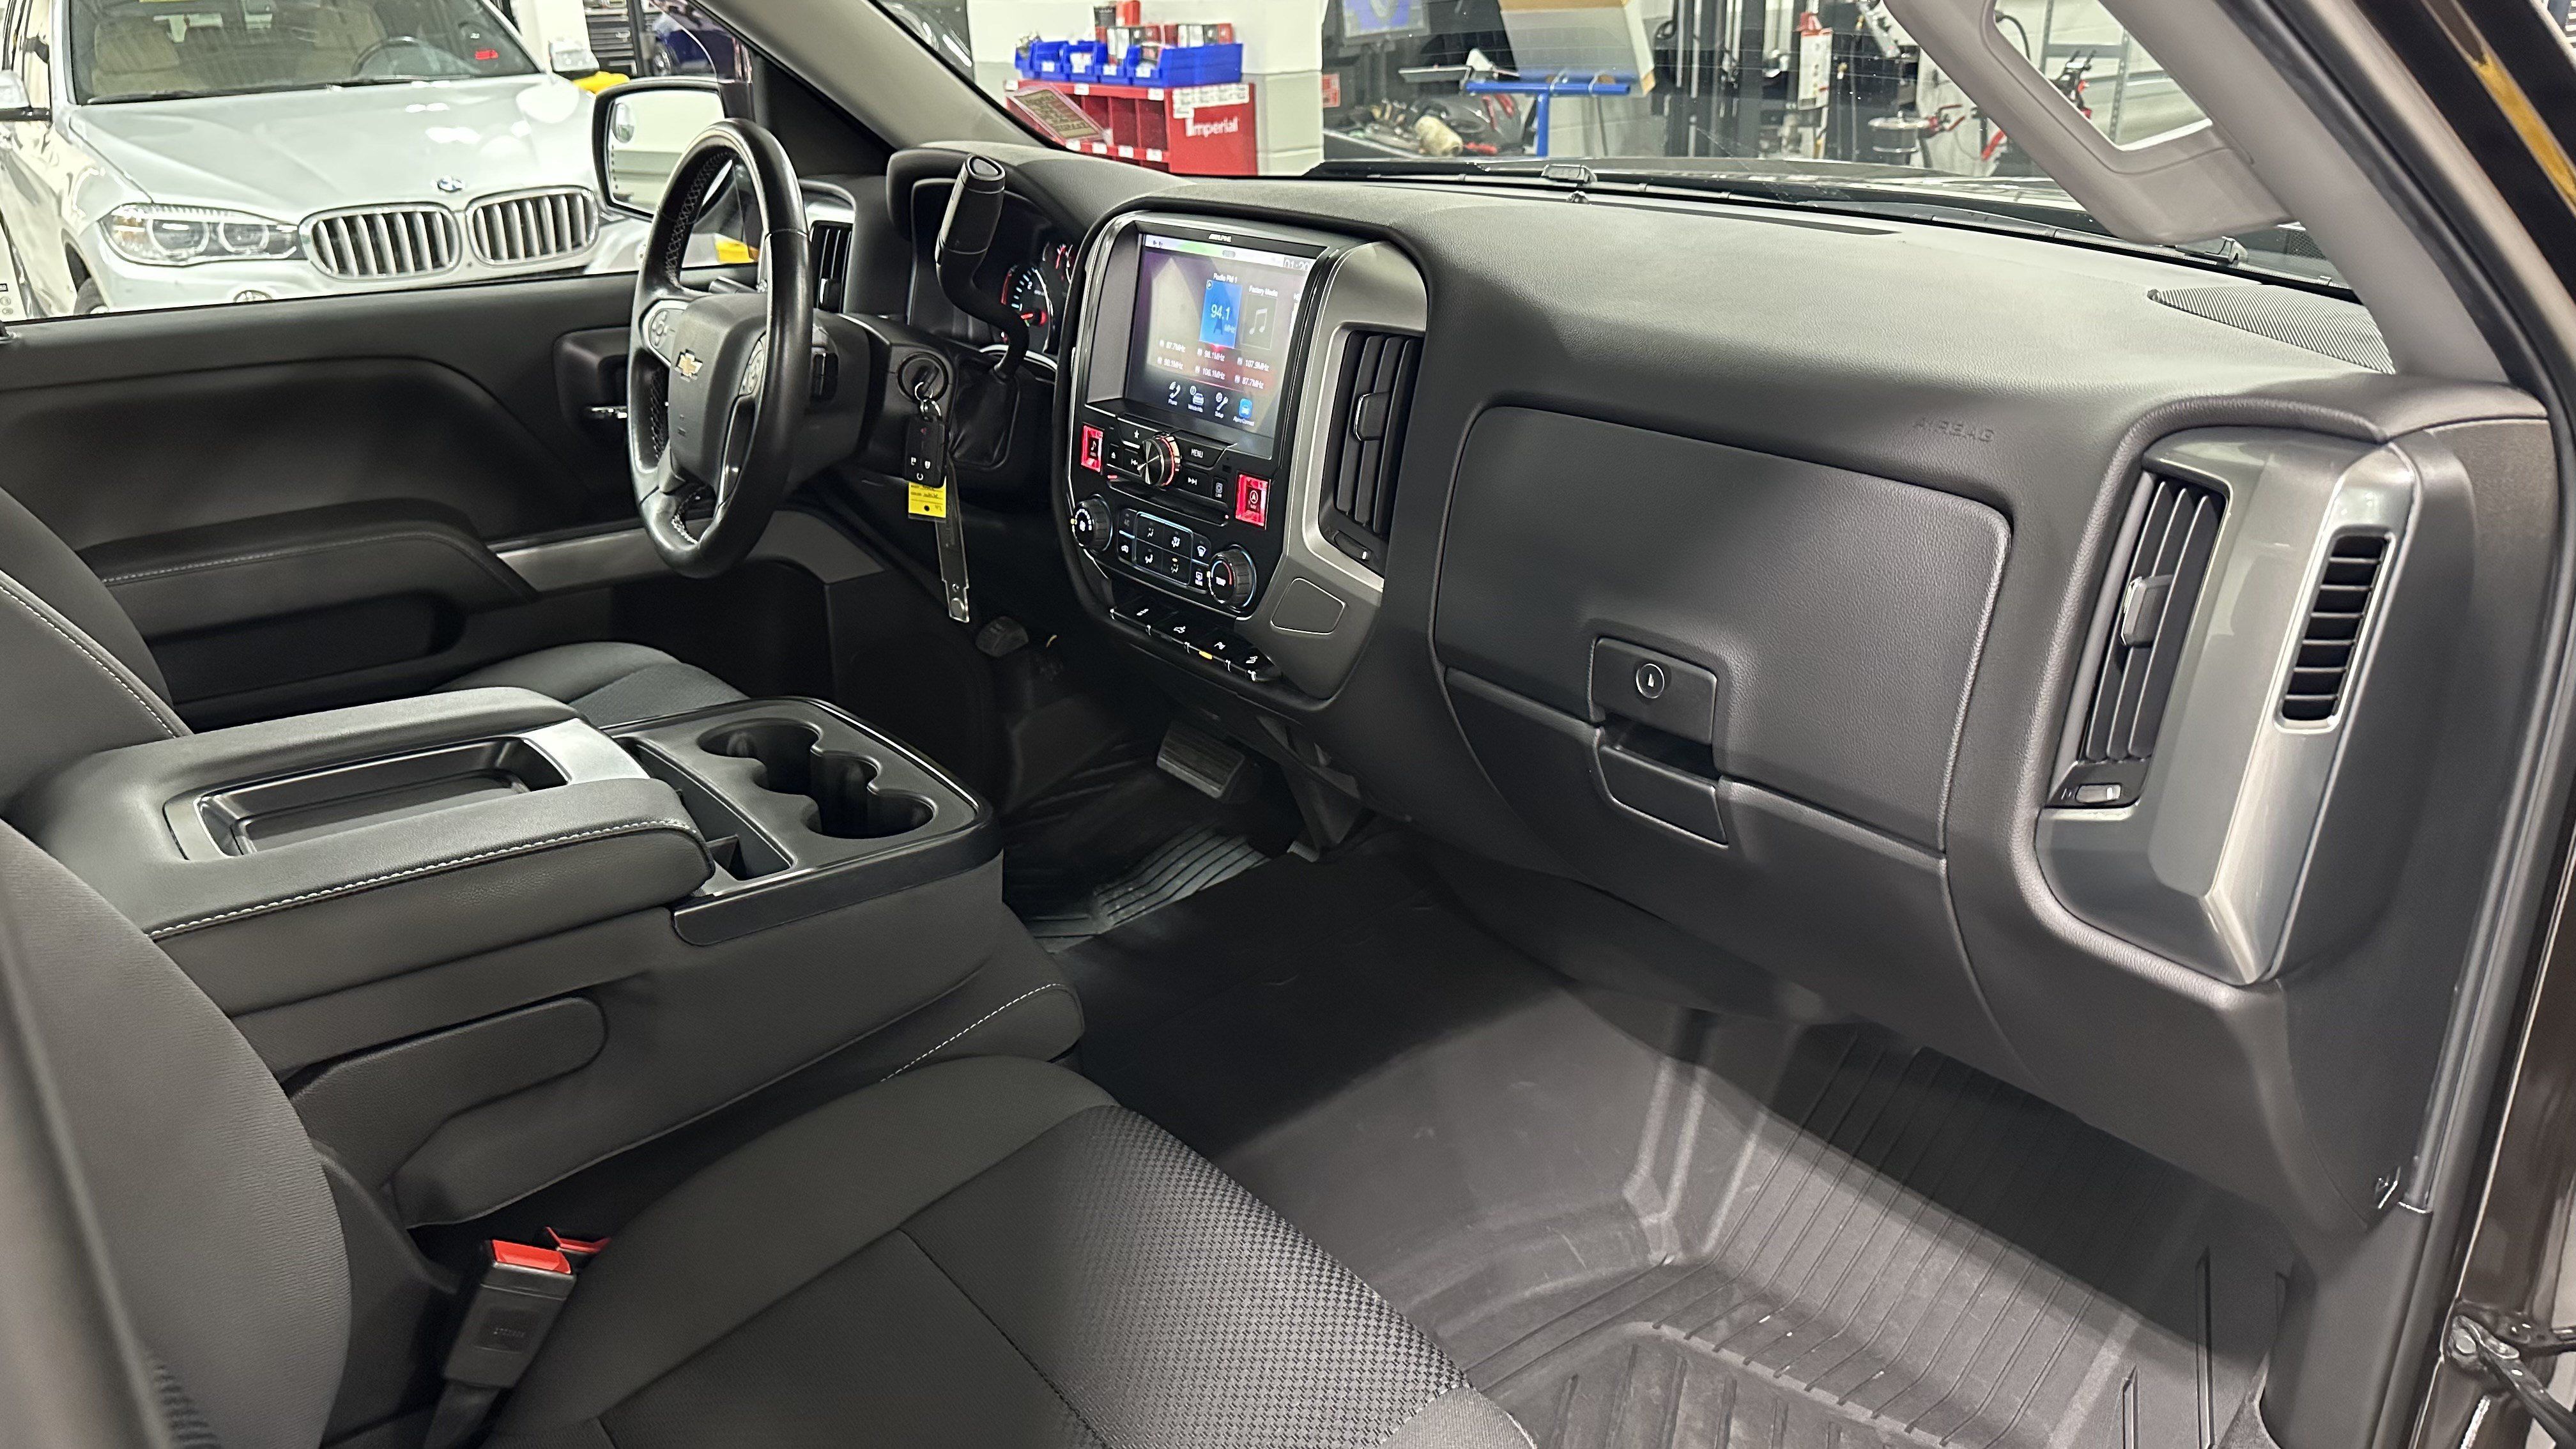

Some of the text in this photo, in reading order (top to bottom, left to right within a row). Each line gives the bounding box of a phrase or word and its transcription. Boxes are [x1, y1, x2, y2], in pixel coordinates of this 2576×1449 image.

[1185, 116, 1239, 137] Imperial
[1211, 303, 1230, 321] 94.1
[1913, 417, 1995, 442] AIRBAG
[1191, 448, 1204, 459] MENU
